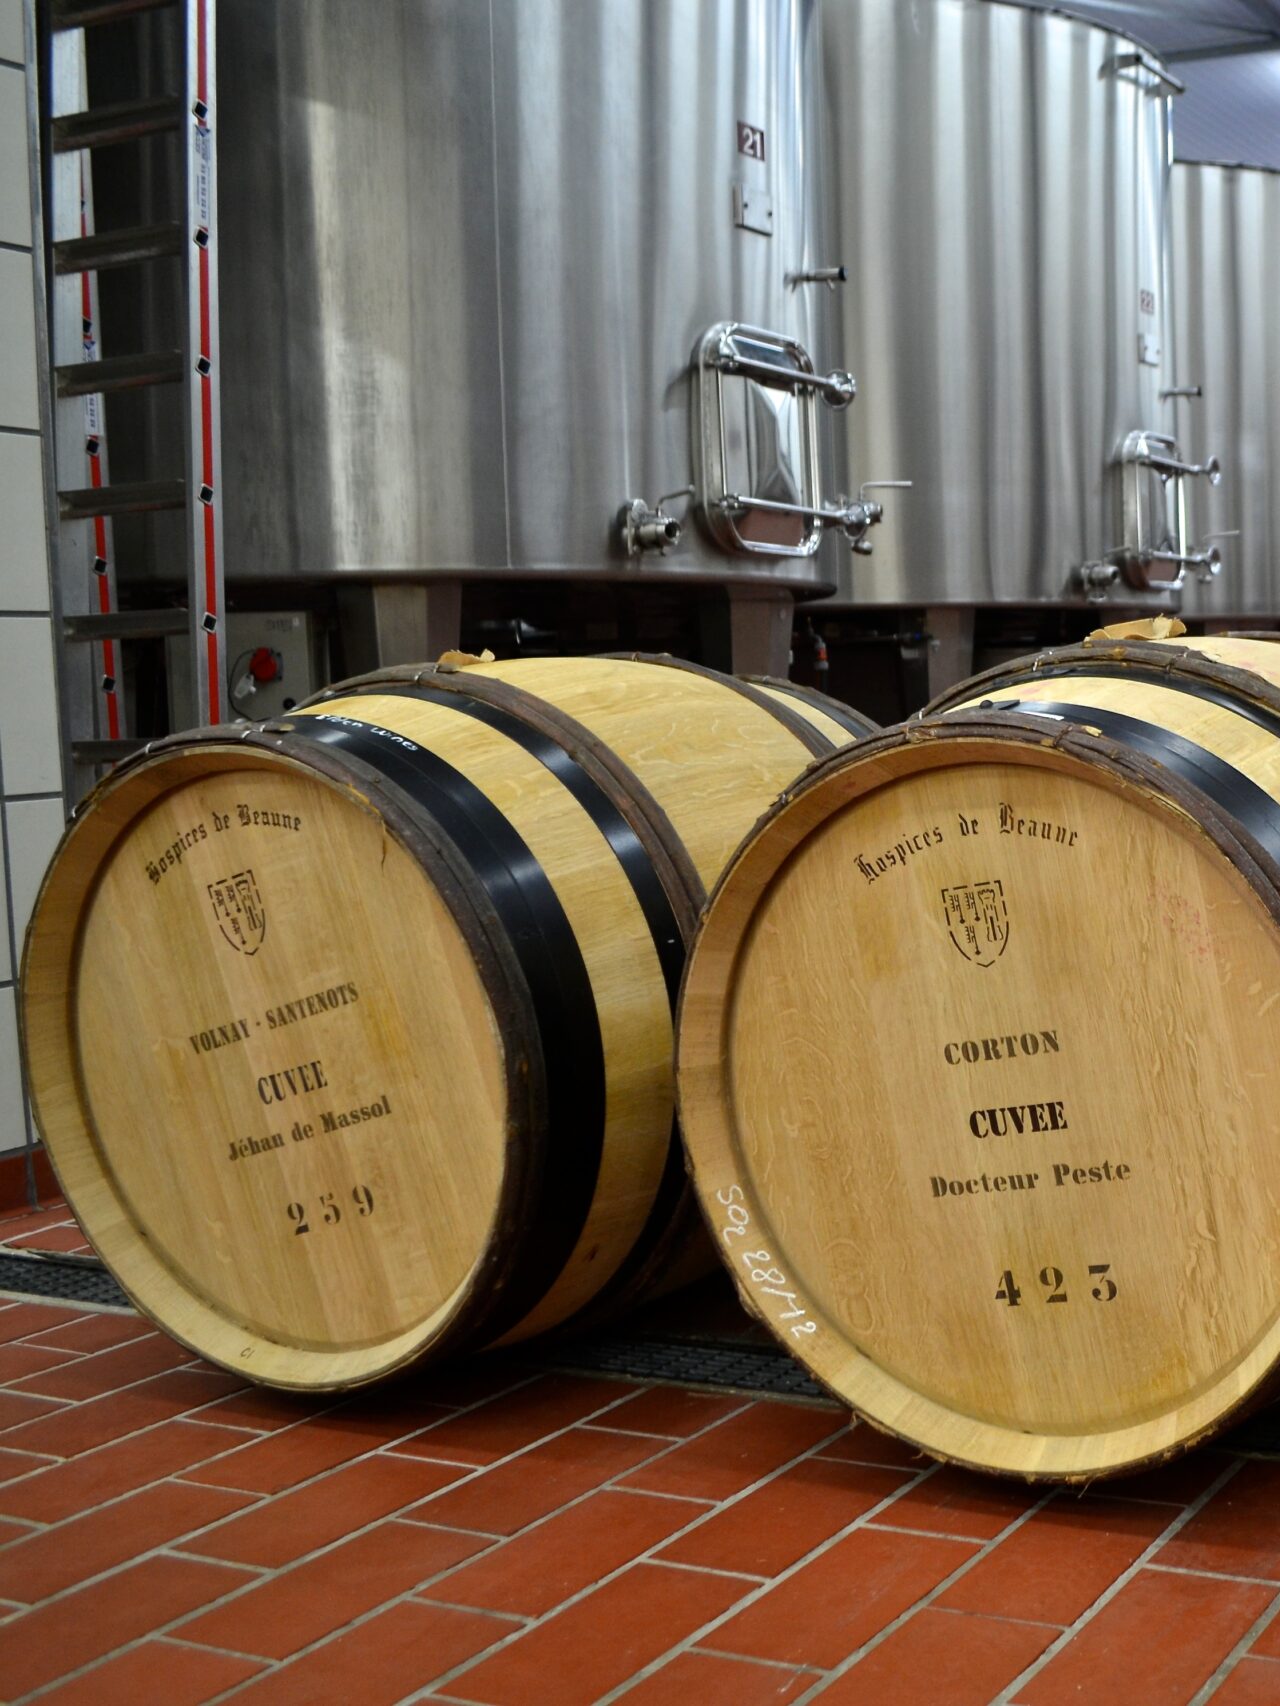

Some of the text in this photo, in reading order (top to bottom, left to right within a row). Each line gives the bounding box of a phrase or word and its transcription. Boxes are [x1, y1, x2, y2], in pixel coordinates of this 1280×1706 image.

[743, 127, 761, 158] 21
[146, 804, 301, 886] Hospices de Beaune
[853, 803, 1079, 884] Hospices de Beaune
[189, 1018, 250, 1055] VOLNAY
[265, 981, 360, 1029] SANTENOTS
[943, 1030, 1061, 1066] CORTON
[257, 1060, 329, 1106] CUVEE
[228, 1095, 393, 1161] Jéhan de Massol
[968, 1101, 1069, 1139] CUVEE
[929, 1160, 1132, 1198] Docteur Peste
